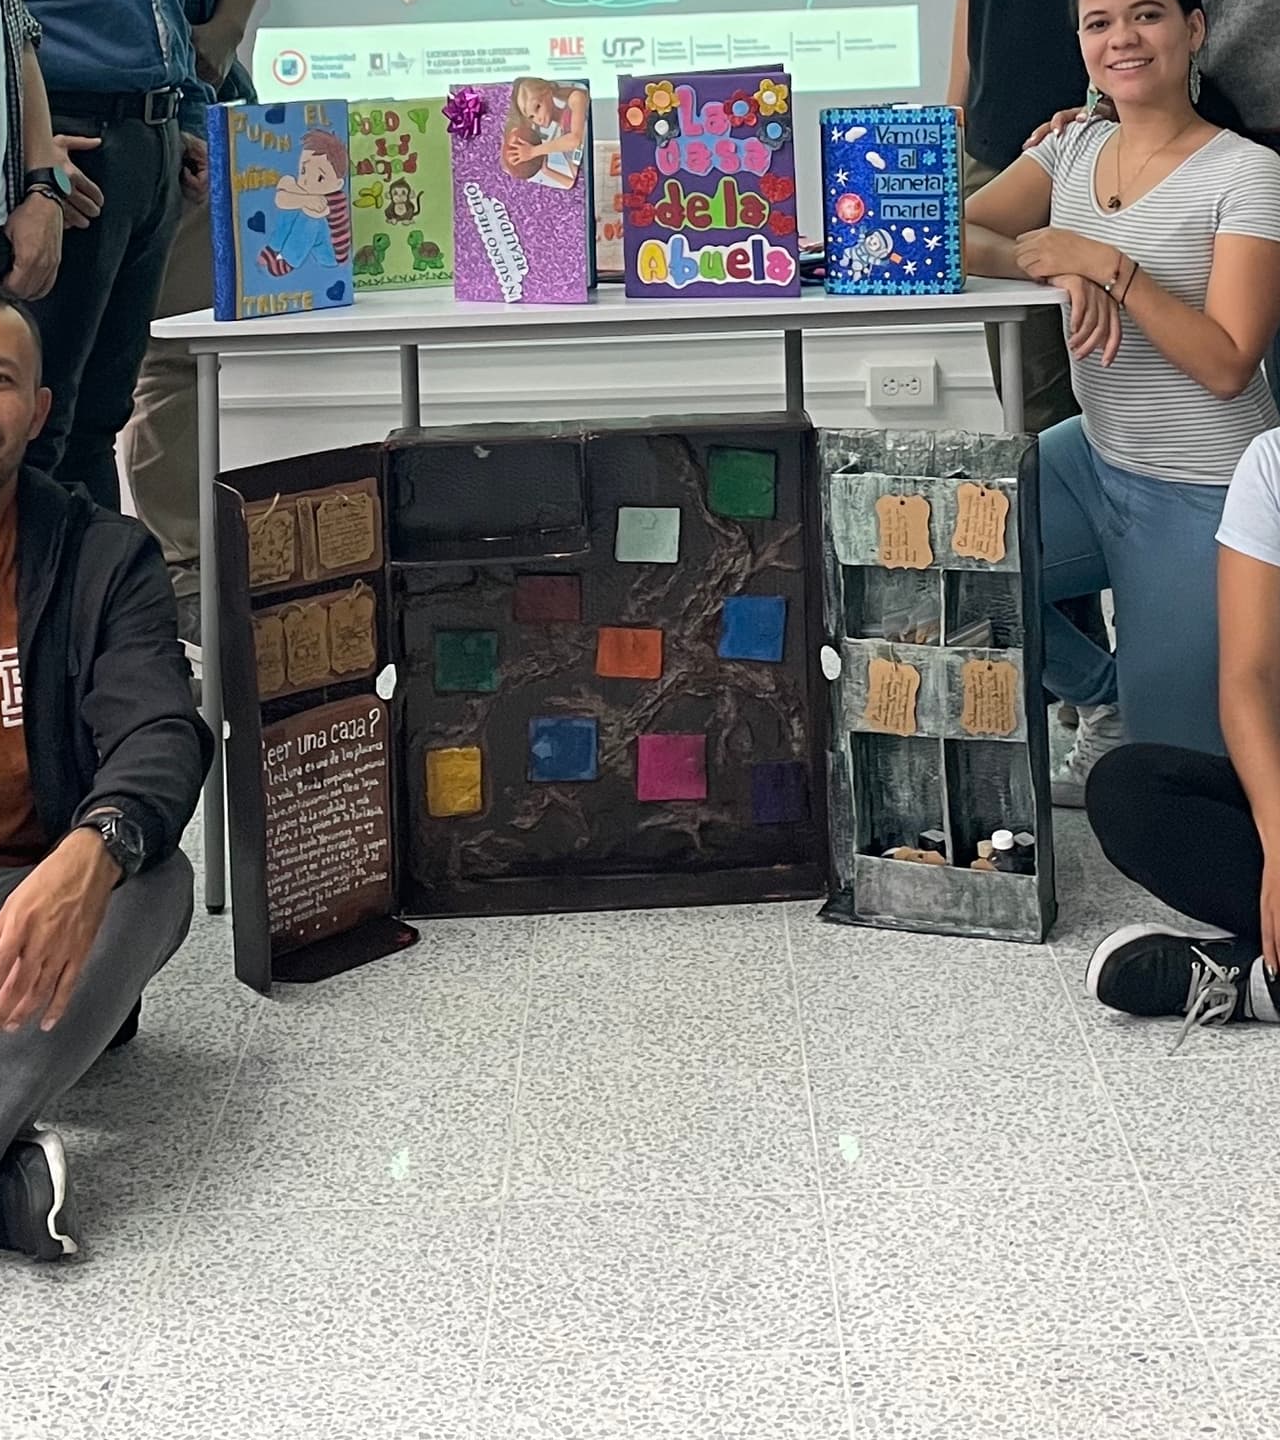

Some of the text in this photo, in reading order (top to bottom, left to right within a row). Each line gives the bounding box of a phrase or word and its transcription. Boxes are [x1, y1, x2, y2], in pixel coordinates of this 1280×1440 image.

[549, 36, 586, 57] PALE
[601, 36, 646, 58] UTP
[675, 84, 730, 137] La
[656, 137, 771, 176] casa
[900, 149, 916, 168] al
[875, 174, 941, 192] planeta
[466, 185, 493, 234] HECHO
[654, 177, 714, 230] de
[722, 178, 769, 228] la
[882, 201, 938, 219] marte
[493, 202, 527, 271] REALIDAD
[639, 235, 796, 288] Abuela
[267, 740, 293, 767] eer
[296, 729, 328, 756] una
